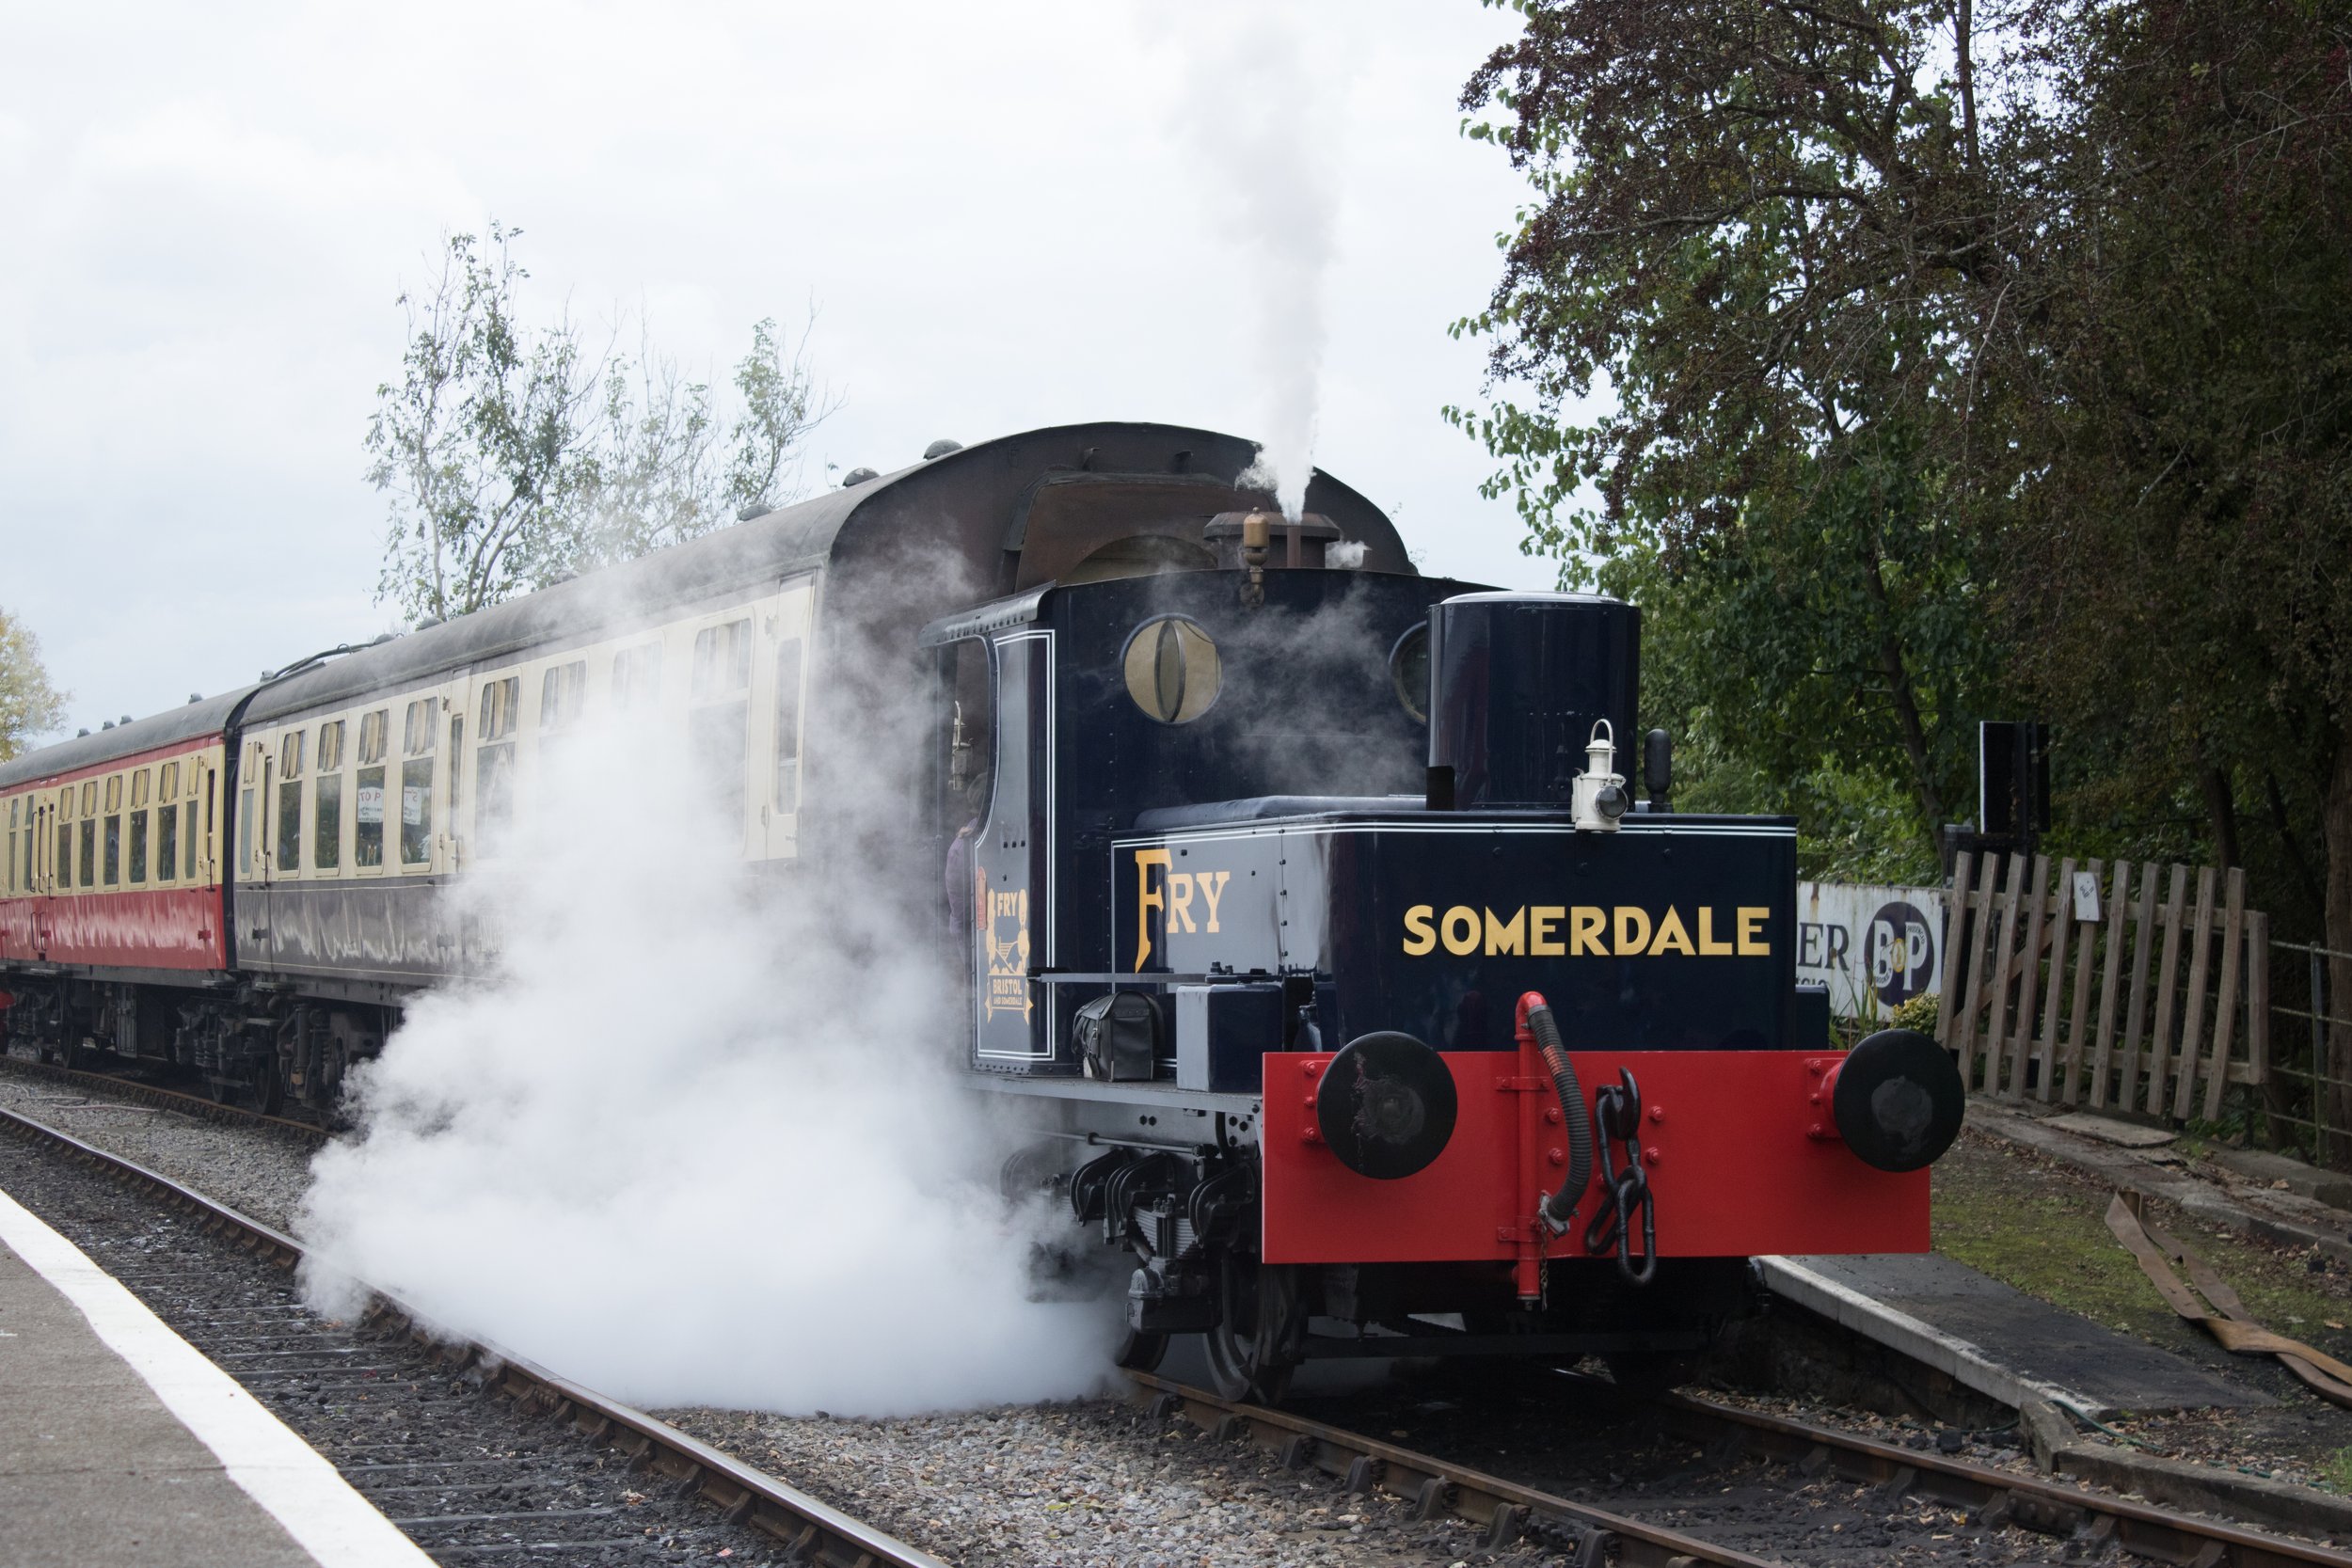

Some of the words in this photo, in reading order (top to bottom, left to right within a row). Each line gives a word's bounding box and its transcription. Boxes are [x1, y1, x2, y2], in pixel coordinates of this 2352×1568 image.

[997, 892, 1018, 917] FRY
[1135, 848, 1230, 974] FRY
[1403, 904, 1771, 957] SOMERDALE
[993, 978, 1023, 995] BRISTOL
